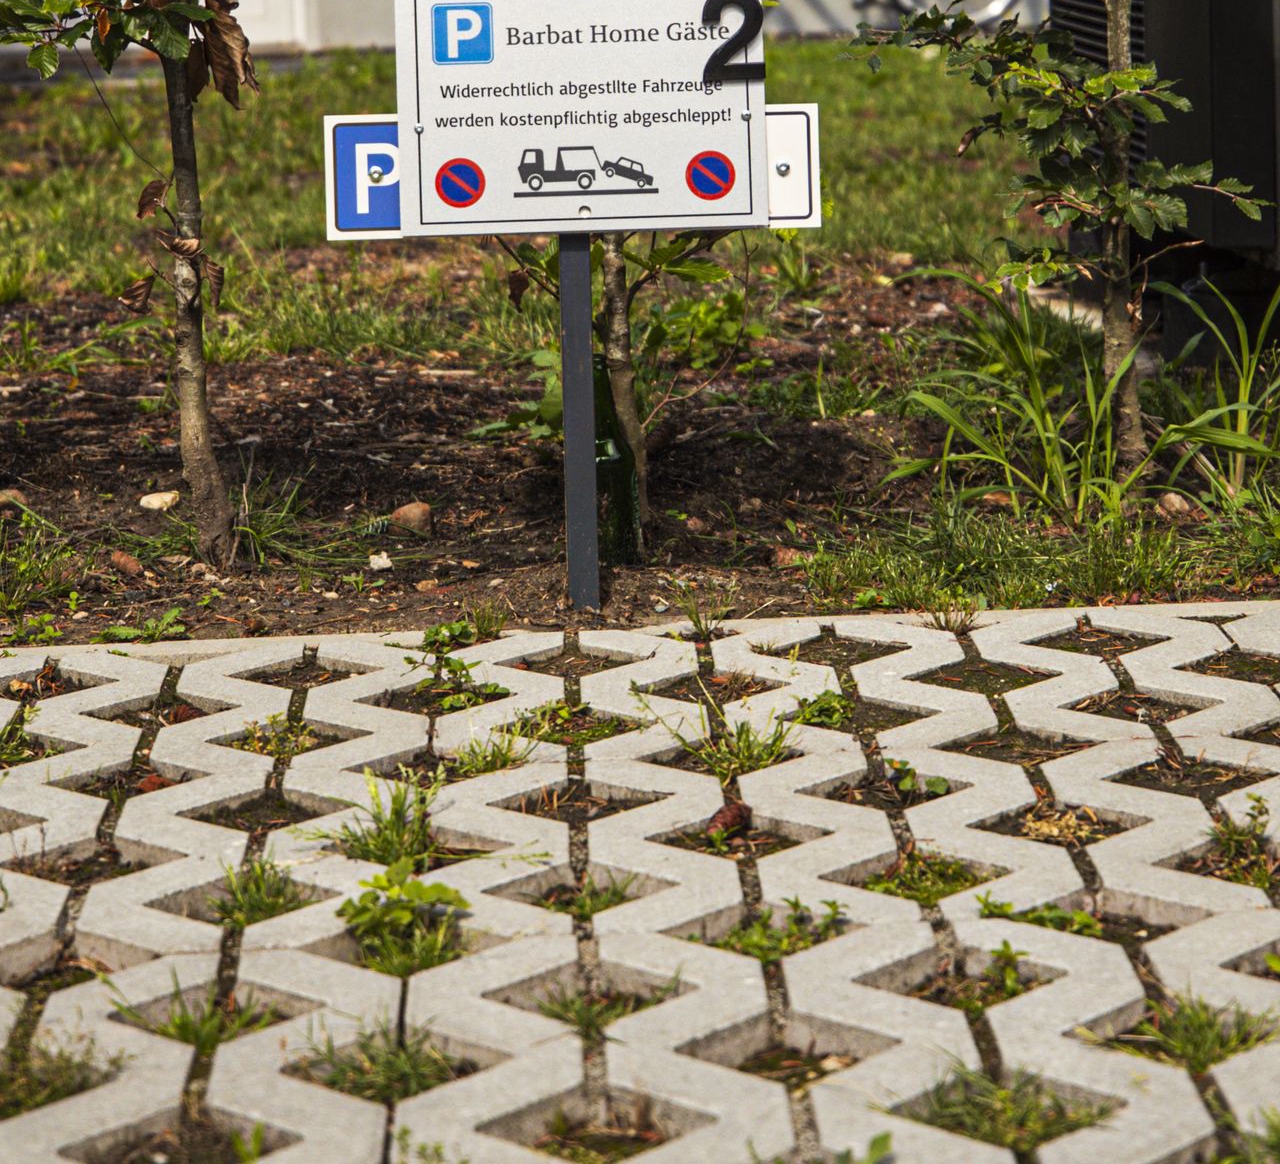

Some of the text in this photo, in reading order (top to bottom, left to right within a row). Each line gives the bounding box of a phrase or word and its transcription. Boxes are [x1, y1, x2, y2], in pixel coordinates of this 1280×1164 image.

[446, 9, 483, 59] P
[506, 21, 730, 45] Barbat Home Gäste
[439, 78, 723, 99] Widerrechtlich abgestllte Fahrzeuge
[434, 107, 732, 131] werden kostenpflichtig abgeschleppt!
[354, 142, 400, 215] P
